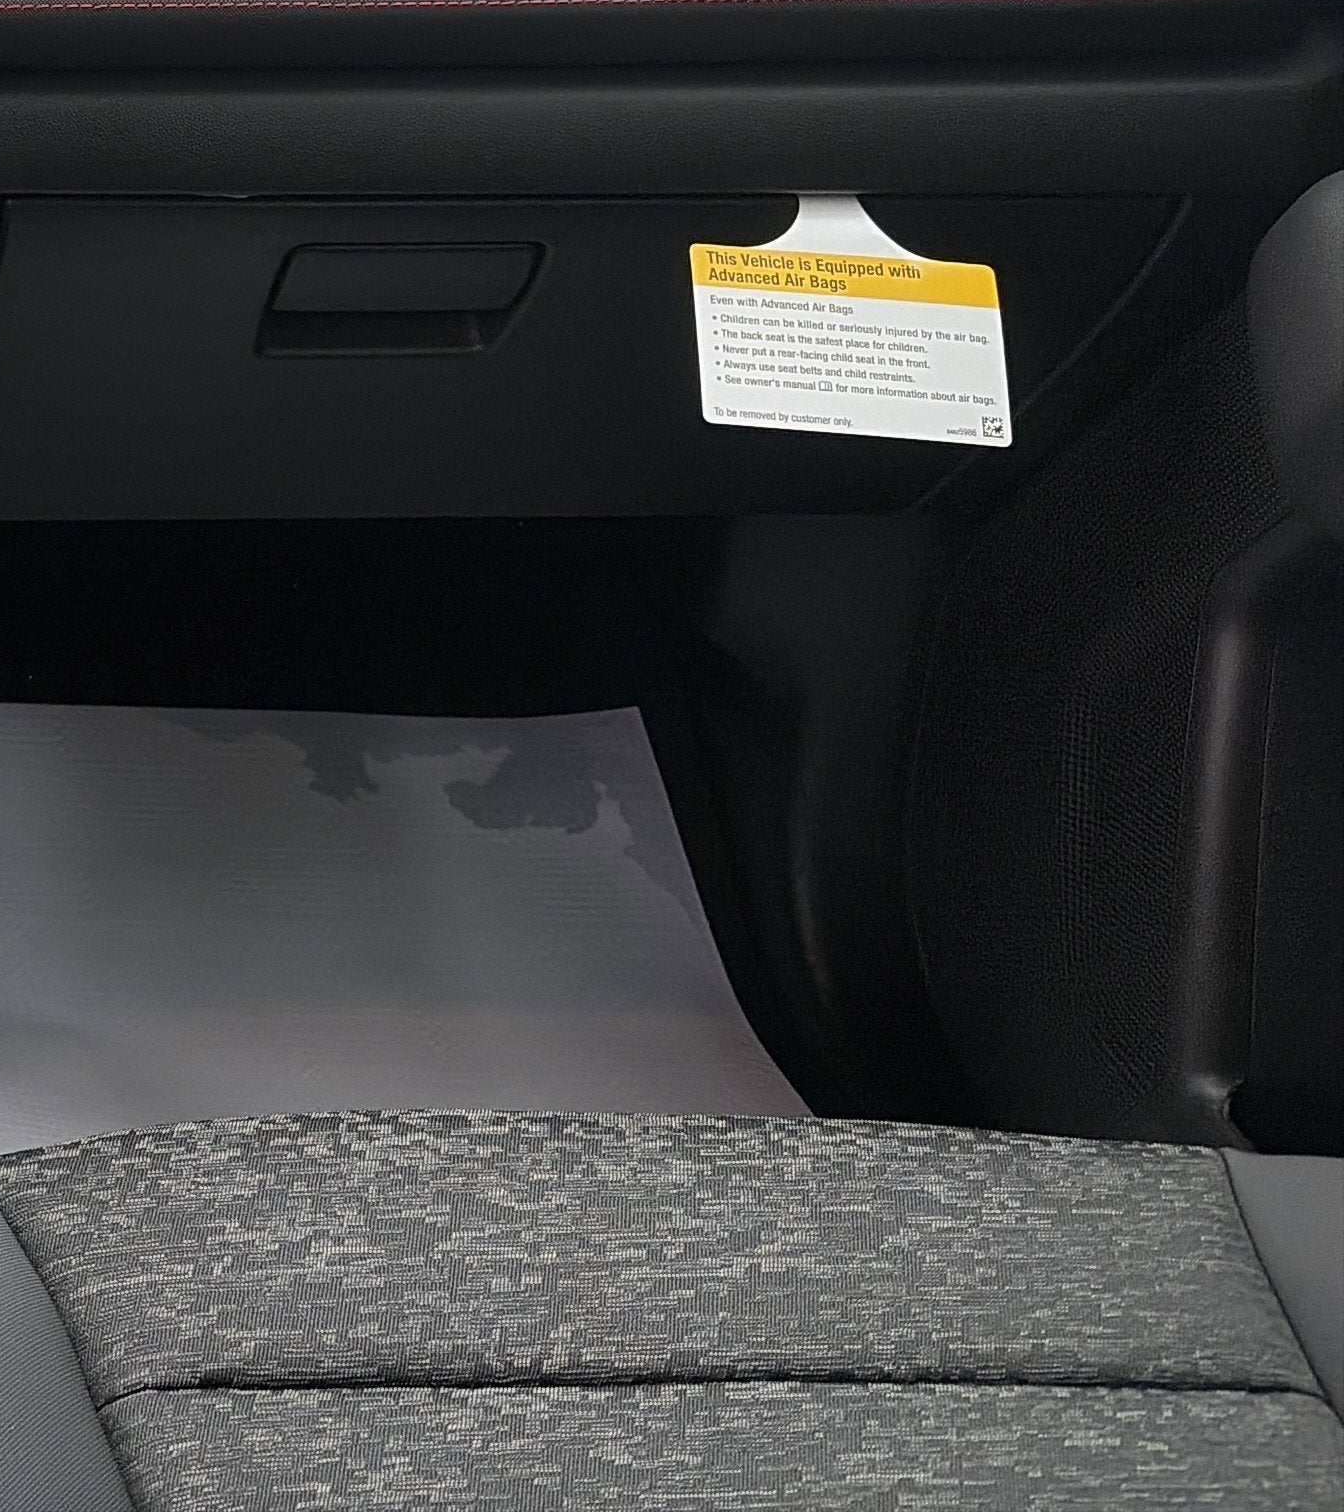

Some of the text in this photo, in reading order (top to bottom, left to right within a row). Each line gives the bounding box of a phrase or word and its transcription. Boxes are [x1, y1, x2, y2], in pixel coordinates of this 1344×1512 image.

[706, 250, 921, 279] This Vehicle is Equipped with
[708, 267, 847, 292] Advanced Air Bags
[710, 294, 854, 316] Even with Advanced Air Bags
[720, 313, 990, 346] Children can be killed or seriously injured by the air bag.
[720, 328, 928, 354] The back seat is the safest place for children.
[722, 344, 931, 369] Never put a rear-facing child seat in the front.
[723, 359, 916, 383] Always use seat belts and child restraints.
[724, 374, 998, 407] See owner's manual for more information about air bags.
[713, 406, 854, 429] To be removed by customer only.
